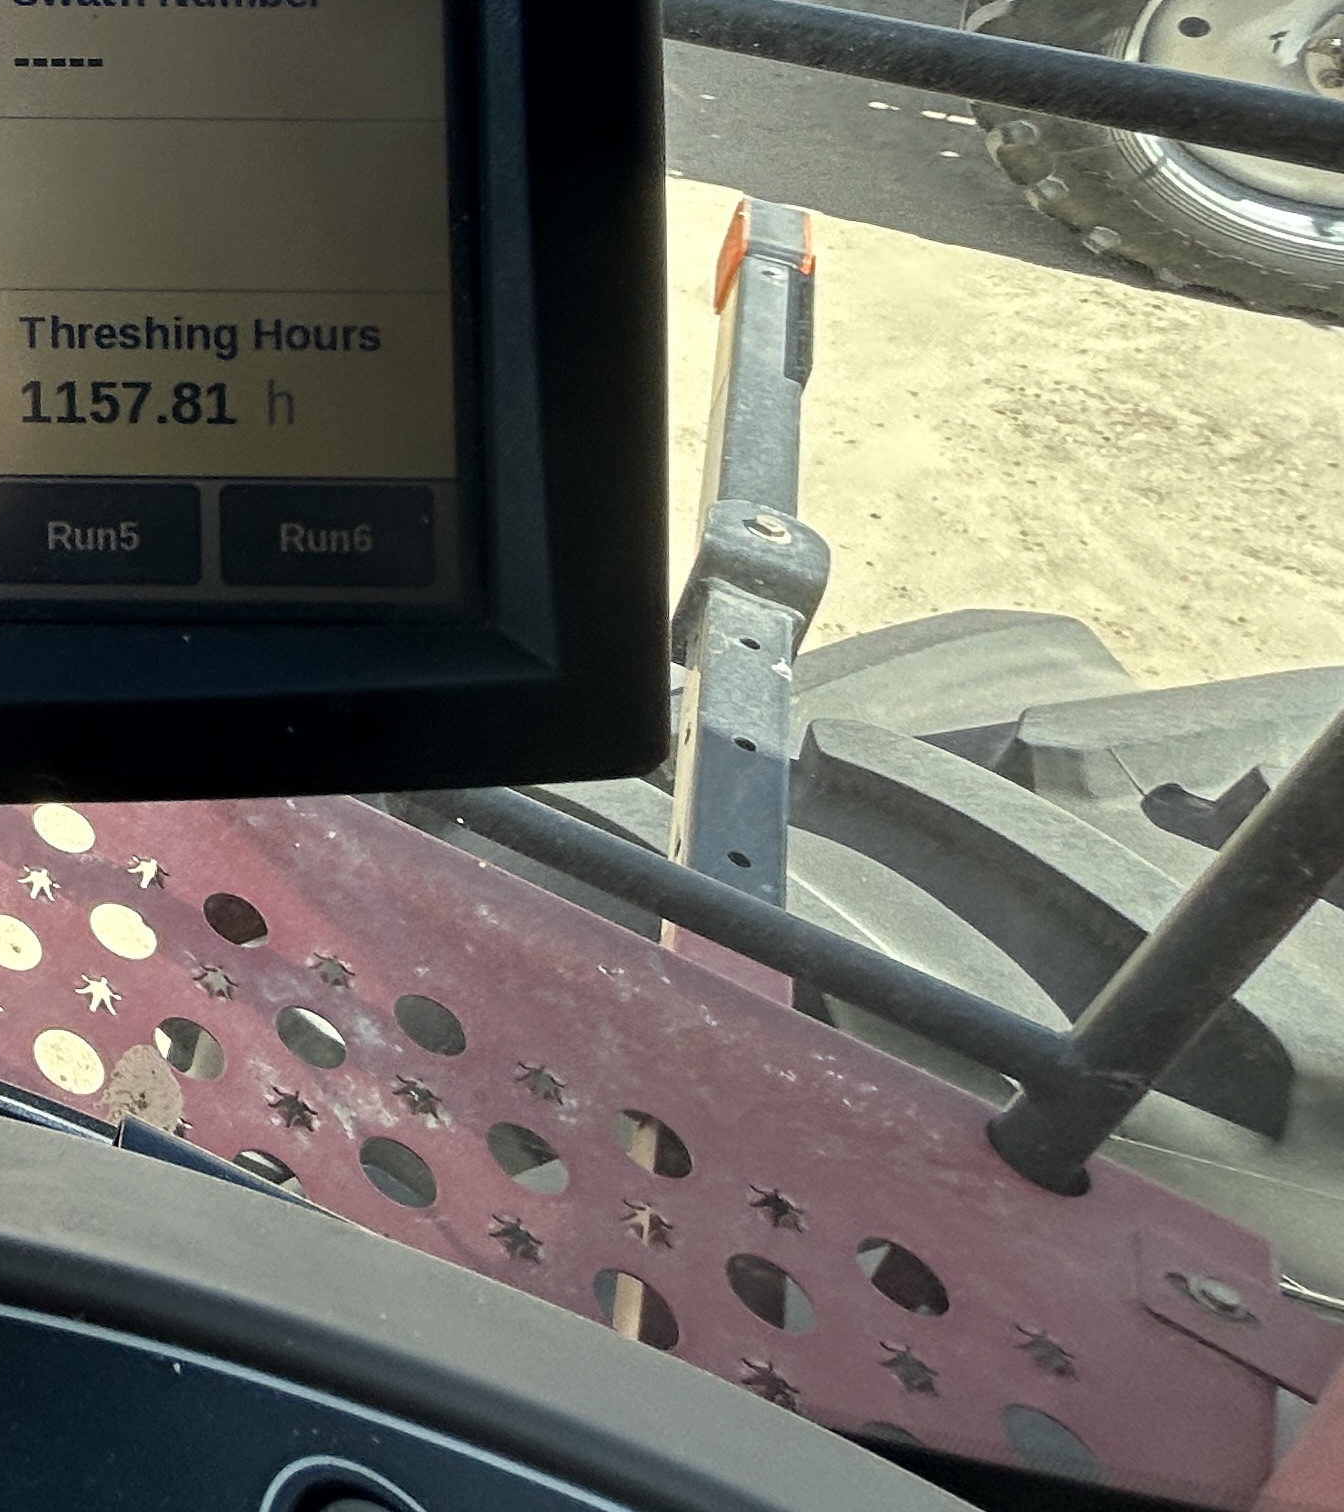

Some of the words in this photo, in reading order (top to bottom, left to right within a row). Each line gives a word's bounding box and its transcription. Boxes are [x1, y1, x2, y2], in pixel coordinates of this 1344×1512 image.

[19, 316, 240, 359] Threshing
[254, 318, 382, 351] Hours
[22, 381, 237, 424] 1157.81
[269, 379, 296, 424] h
[47, 521, 140, 551] Run5
[280, 523, 373, 553] Run6
